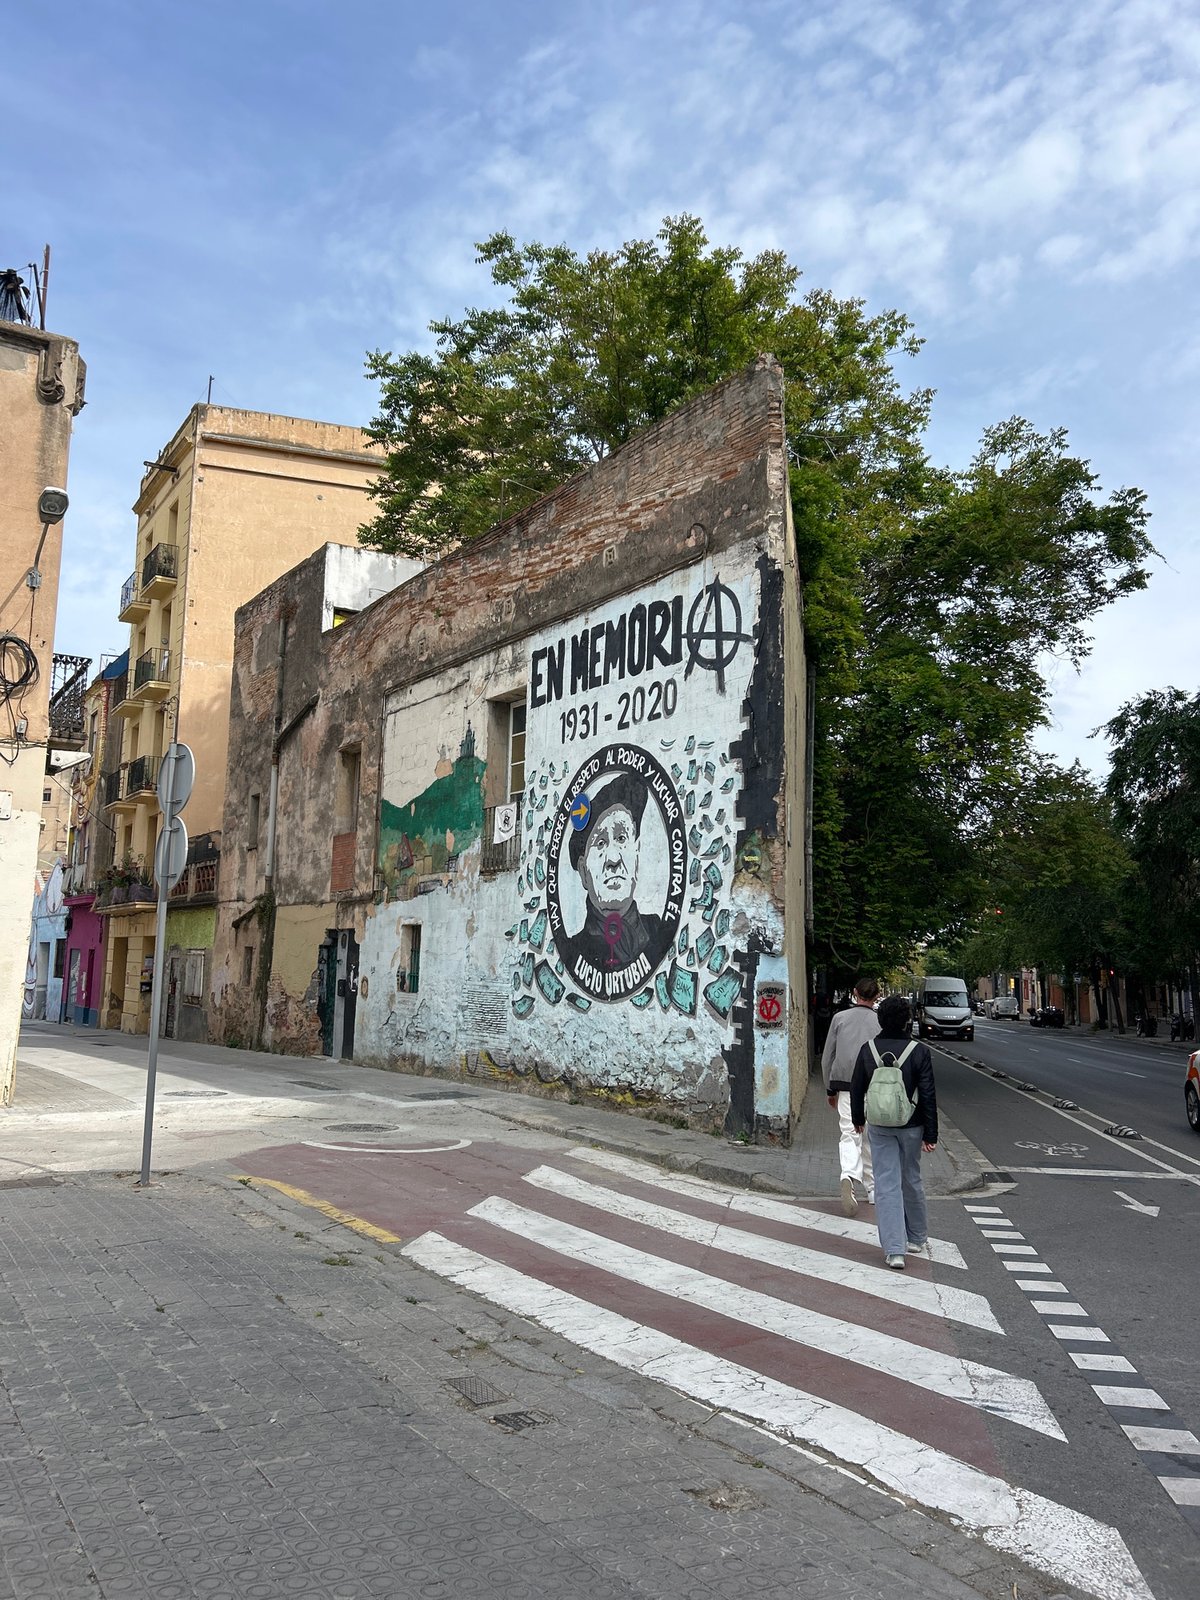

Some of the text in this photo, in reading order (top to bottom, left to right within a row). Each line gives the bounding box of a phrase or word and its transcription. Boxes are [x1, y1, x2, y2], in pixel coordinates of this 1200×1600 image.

[531, 638, 566, 709] EN
[559, 701, 598, 744] 1931
[617, 678, 678, 731] 2020
[571, 759, 600, 798] RESPETO
[604, 749, 616, 767] AL
[617, 747, 646, 773] PODER
[644, 765, 656, 778] Y
[651, 772, 679, 825] LUCHAR
[550, 812, 568, 859] PERDER
[547, 864, 556, 894] QUE
[670, 828, 684, 897] CONTRA
[550, 901, 562, 931] HAY
[573, 954, 603, 994] LUCIO
[605, 952, 652, 995] URTUBIA
